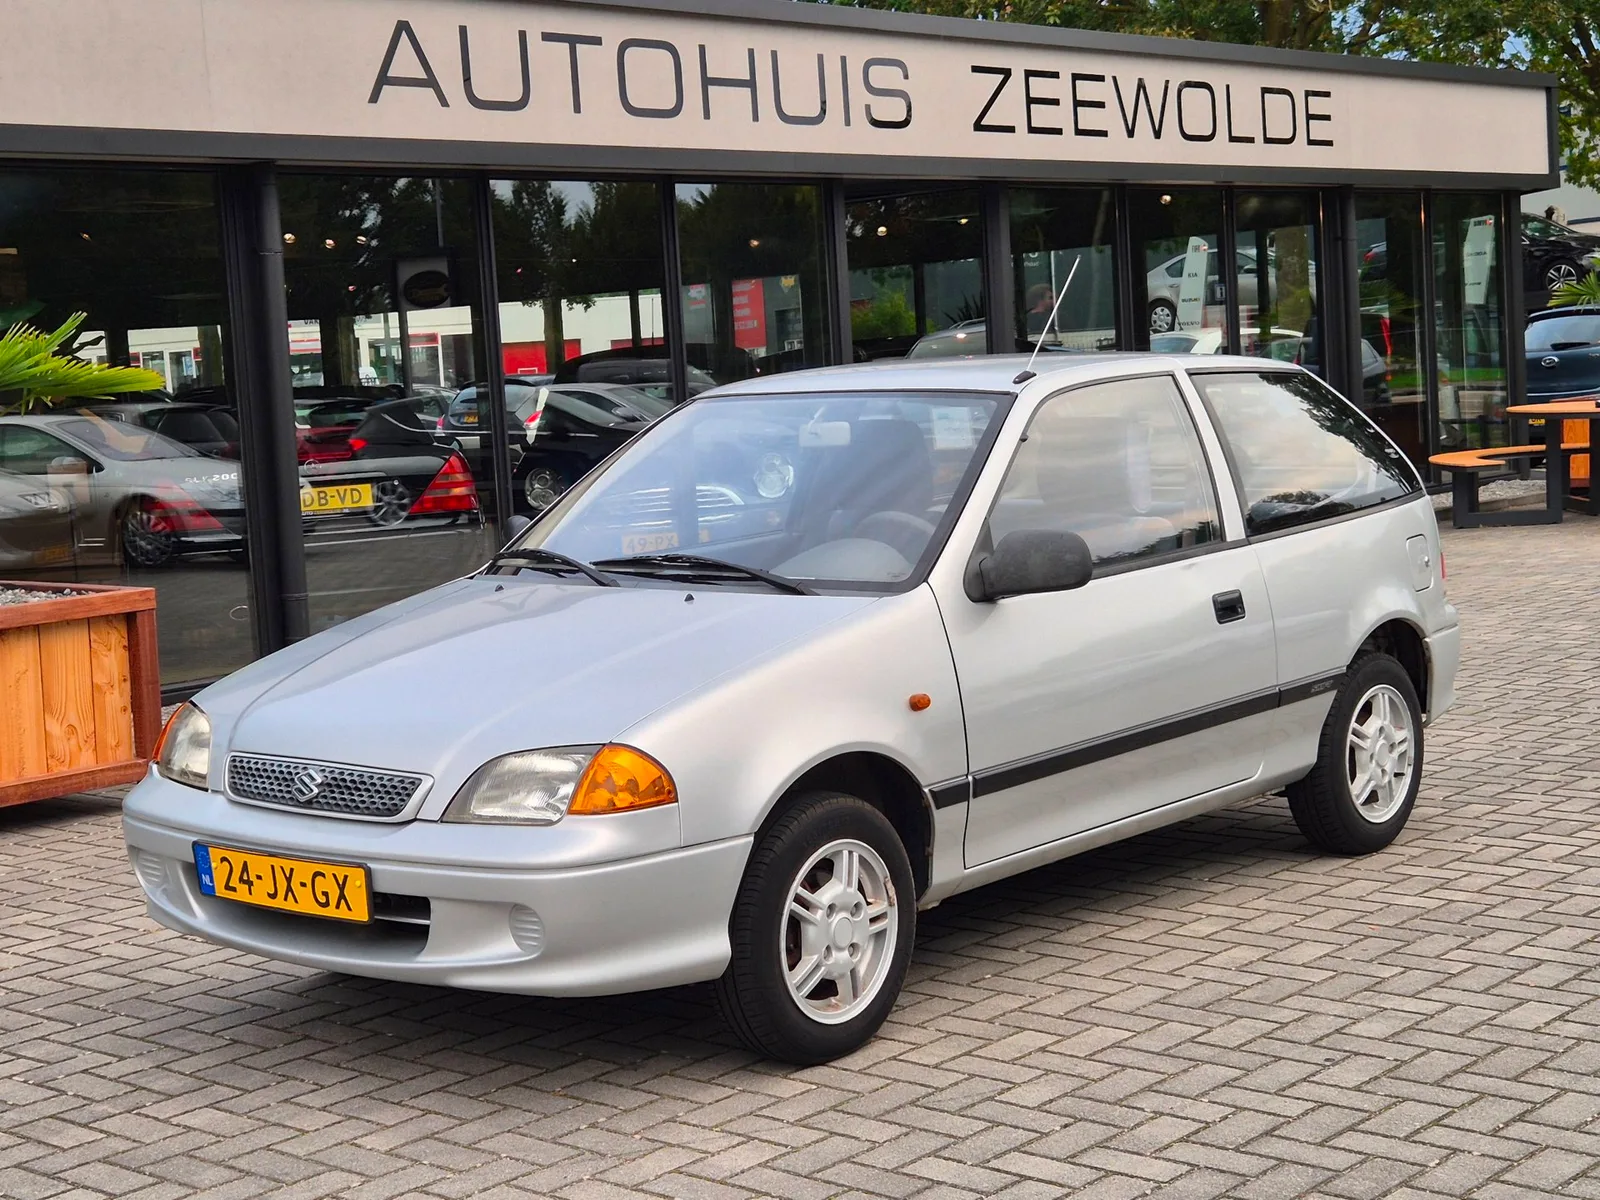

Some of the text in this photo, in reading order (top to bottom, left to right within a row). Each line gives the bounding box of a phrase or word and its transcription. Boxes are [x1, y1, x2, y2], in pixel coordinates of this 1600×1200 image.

[367, 19, 1334, 147] AUTOHUIS ZEEWOLDE
[302, 488, 362, 508] DB-VD
[202, 873, 213, 887] NL
[219, 856, 353, 912] 24-JX-GX
